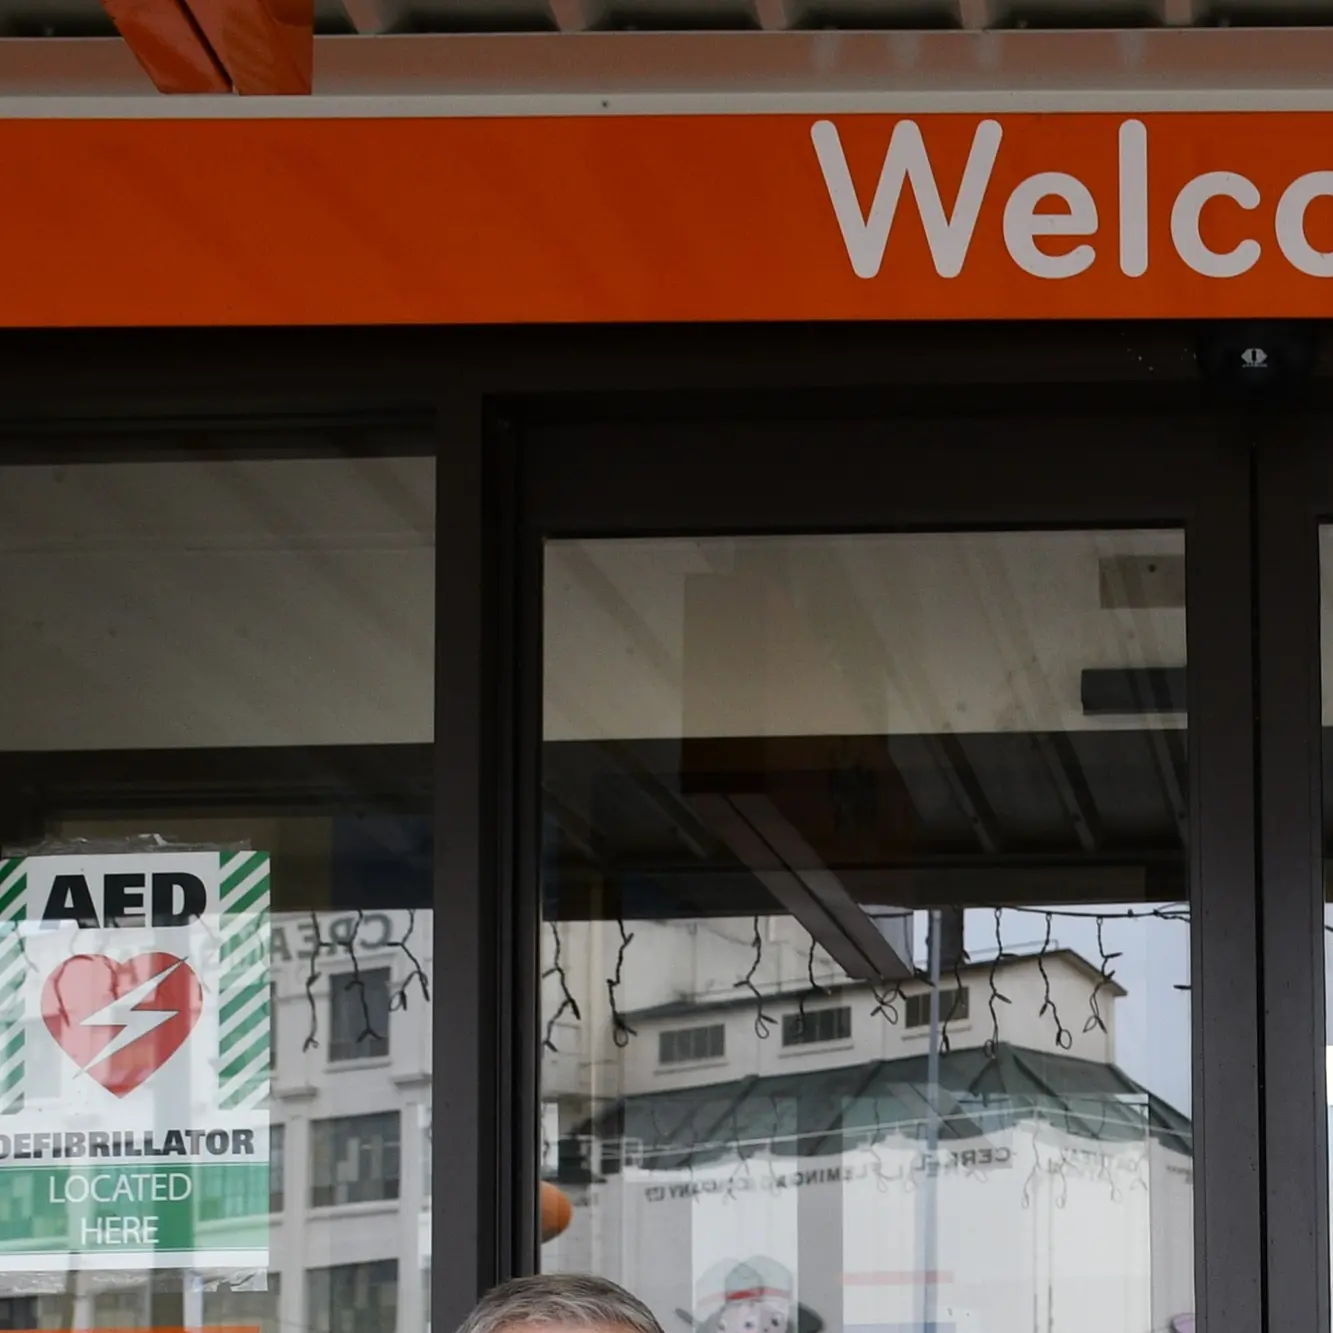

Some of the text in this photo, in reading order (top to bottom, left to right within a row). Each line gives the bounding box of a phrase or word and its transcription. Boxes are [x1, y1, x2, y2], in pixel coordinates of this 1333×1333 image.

[39, 872, 207, 929] AED
[49, 1173, 192, 1202] LOCATED
[81, 1216, 159, 1245] HERE
